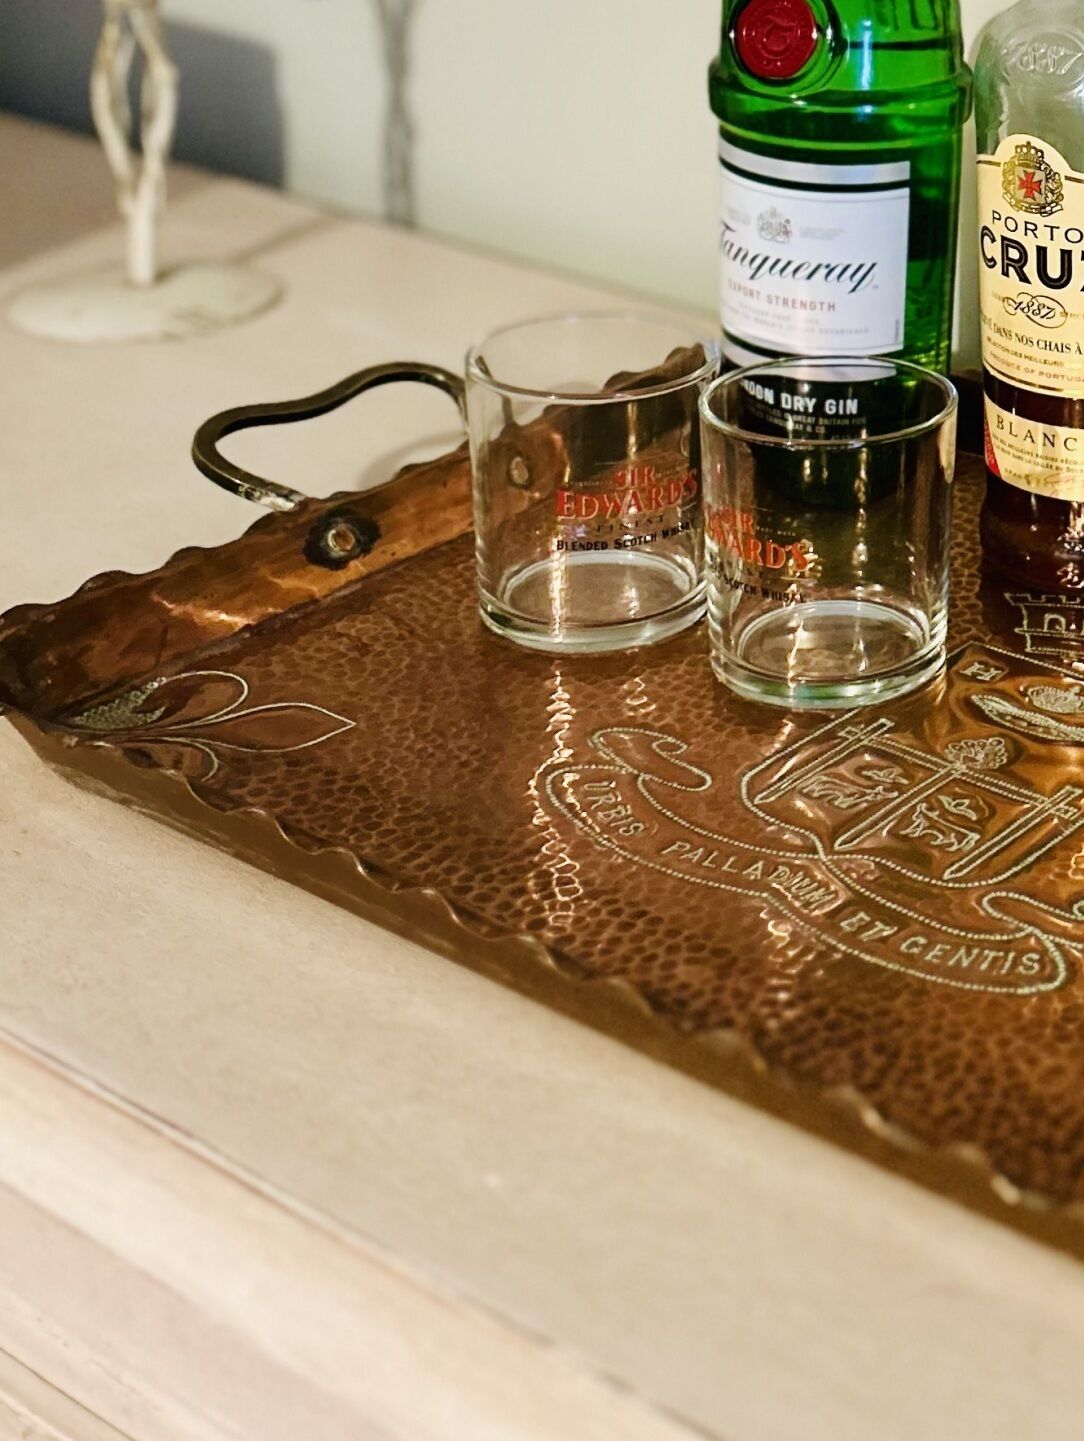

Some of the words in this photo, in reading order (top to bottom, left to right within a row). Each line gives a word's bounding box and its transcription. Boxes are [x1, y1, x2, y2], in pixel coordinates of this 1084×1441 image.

[991, 209, 1084, 244] PORTO
[720, 219, 878, 294] Tanqueray
[727, 278, 761, 301] EXPORT
[765, 293, 837, 313] STRENGTH
[1010, 299, 1057, 321] 1887
[1014, 331, 1035, 348] NOS
[1036, 338, 1072, 355] CHAIS
[1024, 366, 1036, 375] OF
[780, 392, 817, 414] DRY
[824, 398, 859, 416] GIN
[996, 413, 1078, 452] BLANC
[614, 464, 655, 490] SIR
[556, 469, 698, 520] EDWARD'S
[557, 540, 609, 551] BLENDED
[613, 533, 657, 550] SCOTCH
[583, 779, 646, 837] URBIS
[661, 840, 836, 909] PALLADIUM
[839, 910, 899, 942] ET
[900, 935, 1041, 976] GENTIS
